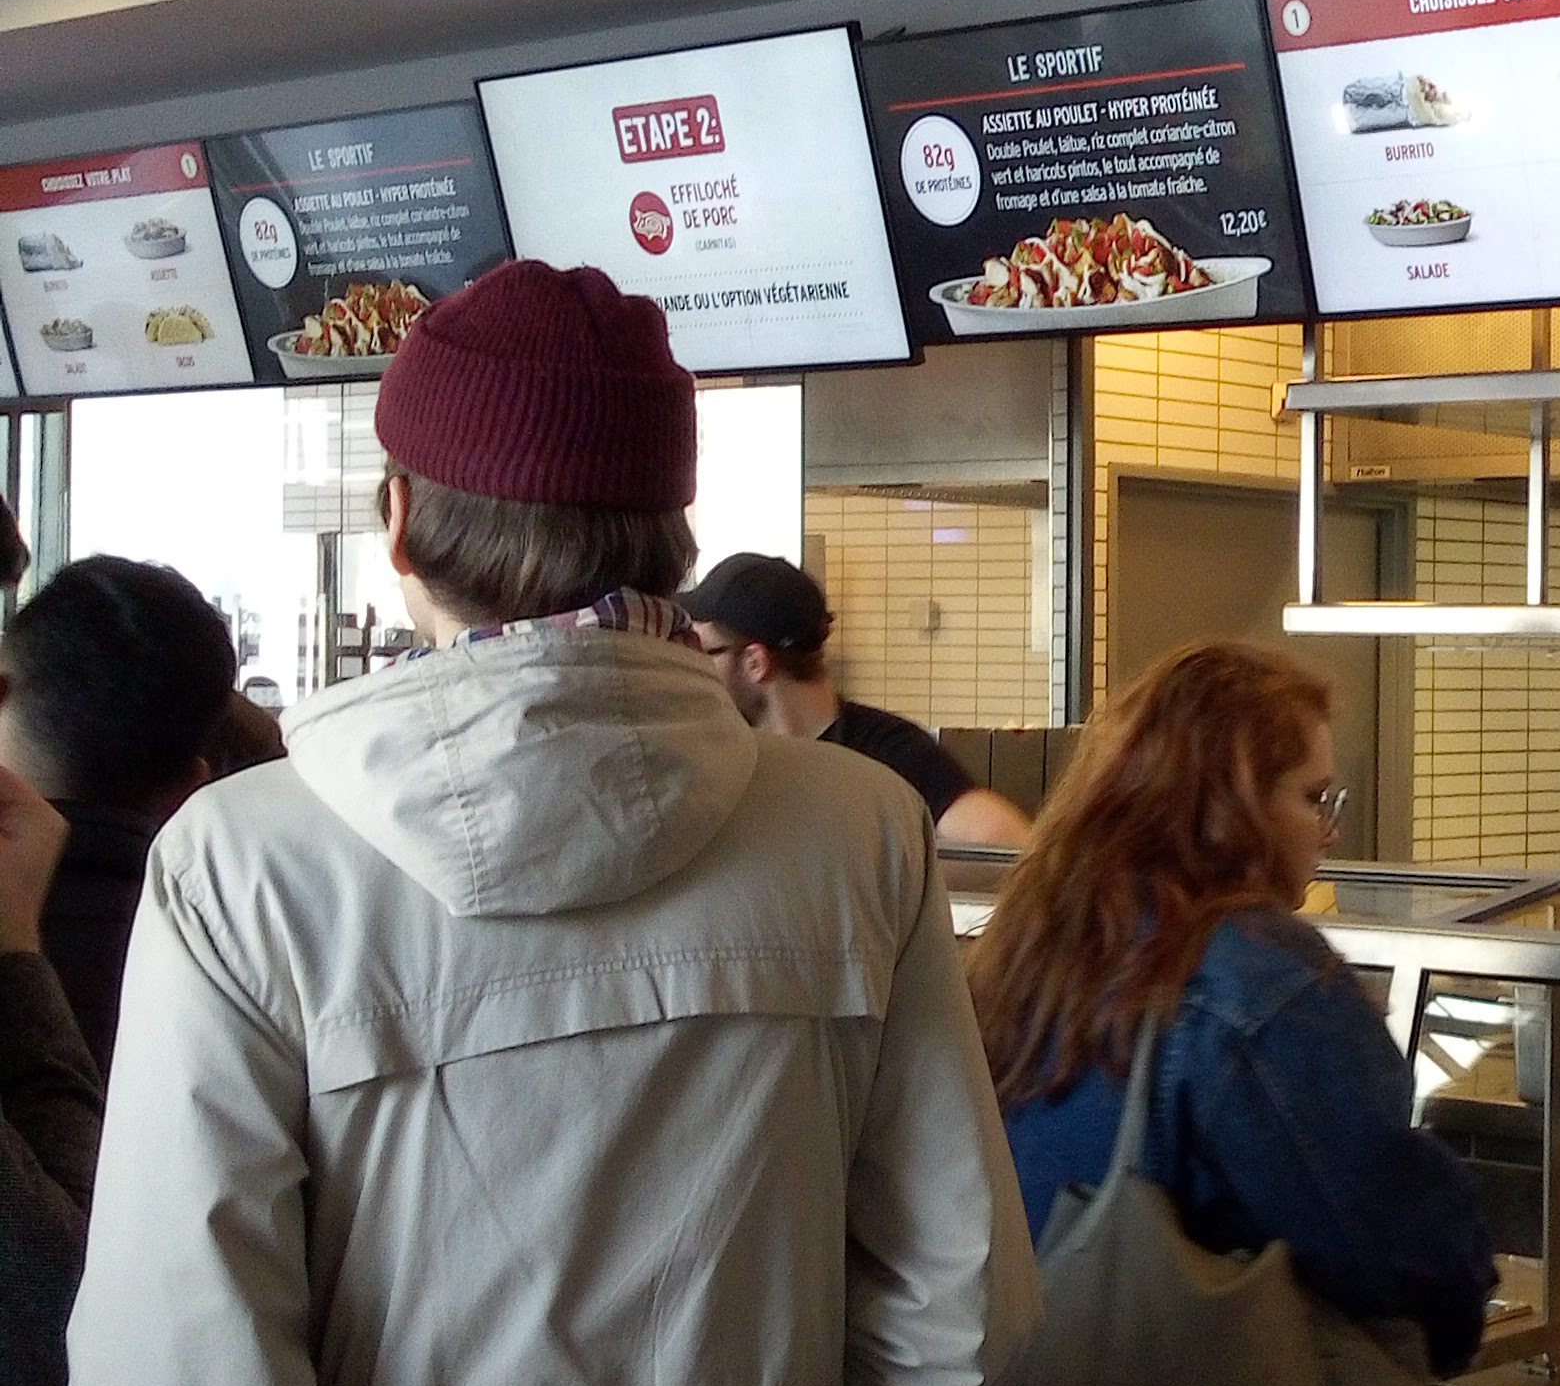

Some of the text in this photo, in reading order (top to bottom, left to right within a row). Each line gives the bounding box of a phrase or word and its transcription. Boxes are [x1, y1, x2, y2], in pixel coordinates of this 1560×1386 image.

[1007, 46, 1104, 83] LE SPORTIF
[983, 111, 1034, 134] ASSIETTE
[1036, 109, 1053, 128] AU
[1054, 103, 1099, 126] POULET
[1108, 96, 1150, 121] HYPER
[1150, 84, 1220, 116] PROTÉINÉE
[618, 108, 721, 155] ETAPE 2:
[986, 141, 1021, 161] Double
[1022, 138, 1058, 157] Poulet,
[1092, 131, 1105, 150] riz
[1106, 126, 1149, 150] complet
[308, 143, 374, 171] LE SPORTIF
[923, 144, 956, 172] 82g
[991, 170, 1012, 186] vert
[1013, 169, 1025, 184] et
[1026, 164, 1067, 182] haricots
[1102, 158, 1112, 174] le
[1113, 156, 1137, 173] tout
[1137, 146, 1204, 171] accompagné
[1205, 146, 1220, 165] de
[1385, 142, 1435, 161] BURRITO
[670, 174, 740, 205] EFFILOCHÉ
[915, 180, 927, 195] DE
[995, 192, 1038, 212] fromage
[1040, 192, 1051, 207] et
[1081, 187, 1107, 204] salsa
[1108, 182, 1116, 200] à
[1116, 182, 1127, 199] la
[1128, 179, 1166, 198] tomate
[255, 220, 278, 243] 82g
[683, 205, 738, 229] DE PORC
[1406, 262, 1450, 280] SALADE
[655, 281, 850, 312] IANDE OU L'OPTION VÉGÉTARIENNE
